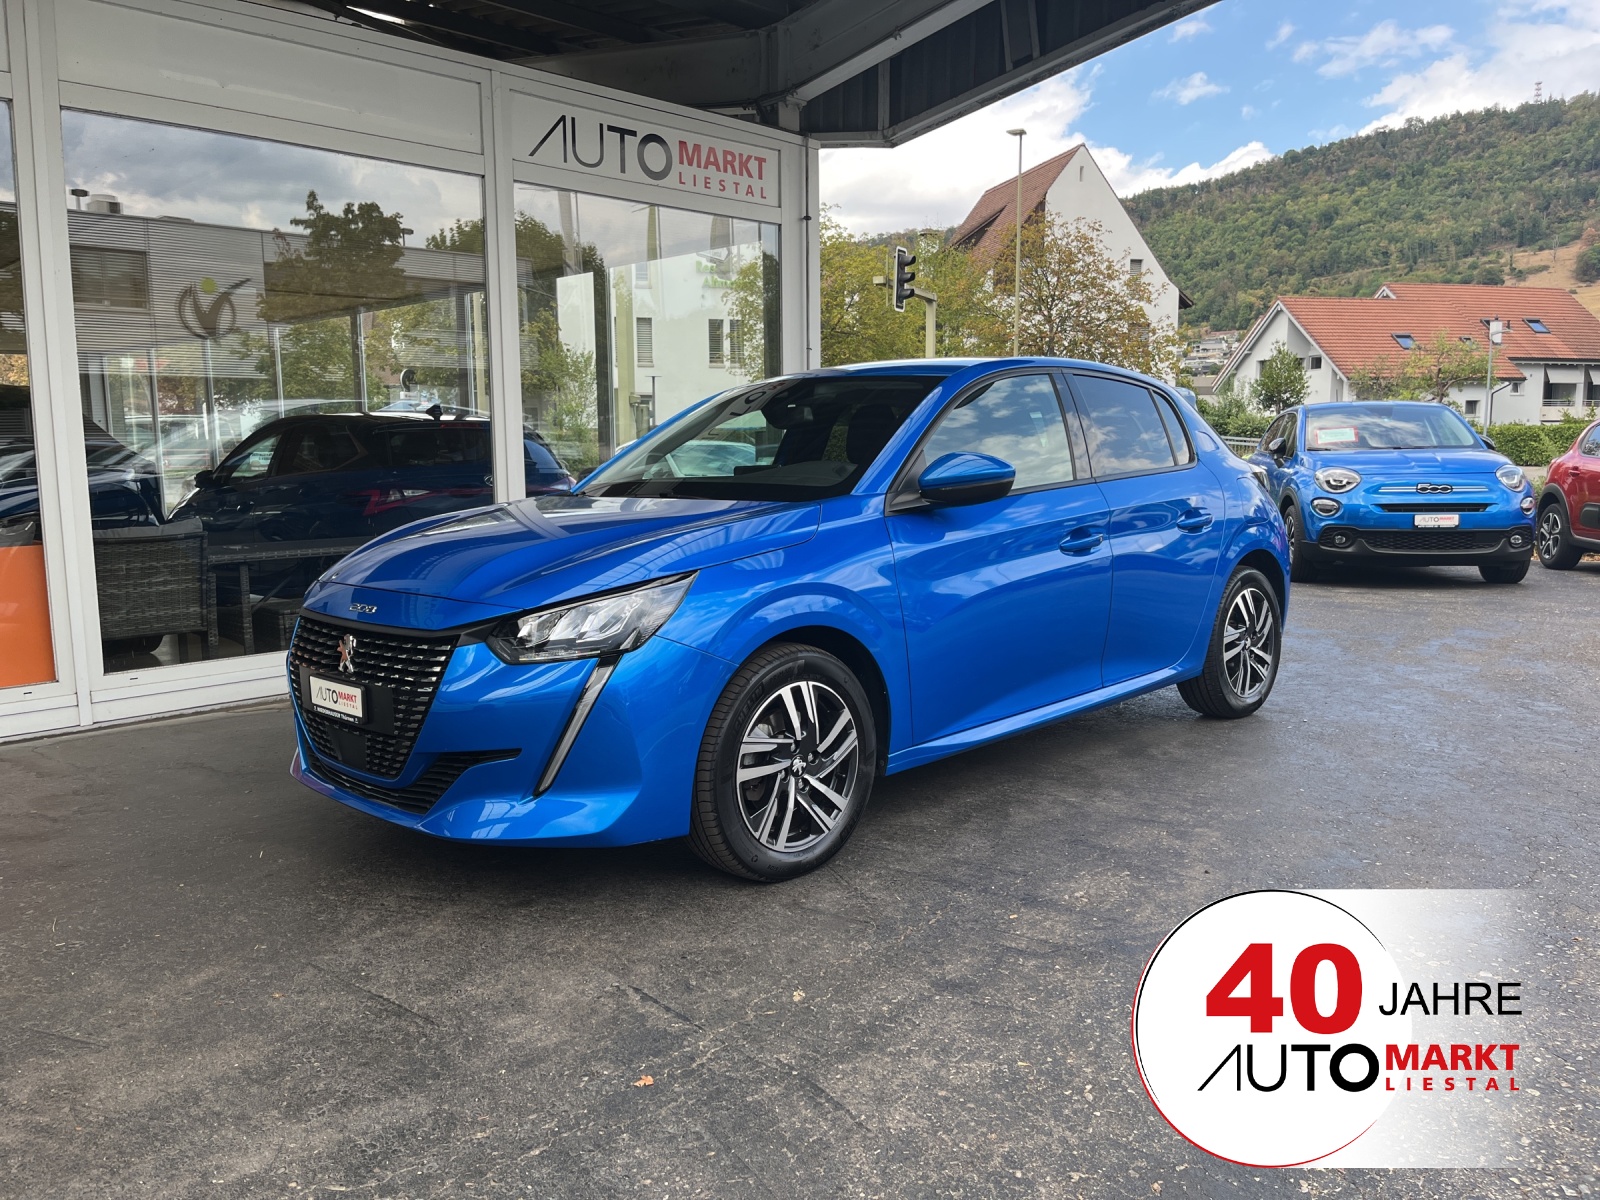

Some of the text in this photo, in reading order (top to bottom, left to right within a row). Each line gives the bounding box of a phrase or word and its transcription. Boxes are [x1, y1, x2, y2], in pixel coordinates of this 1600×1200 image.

[528, 114, 767, 181] AUTO MARKT
[678, 171, 767, 199] LIESTAL
[1417, 483, 1452, 494] 500
[349, 603, 377, 614] 208
[316, 686, 357, 704] AUTO MARKT
